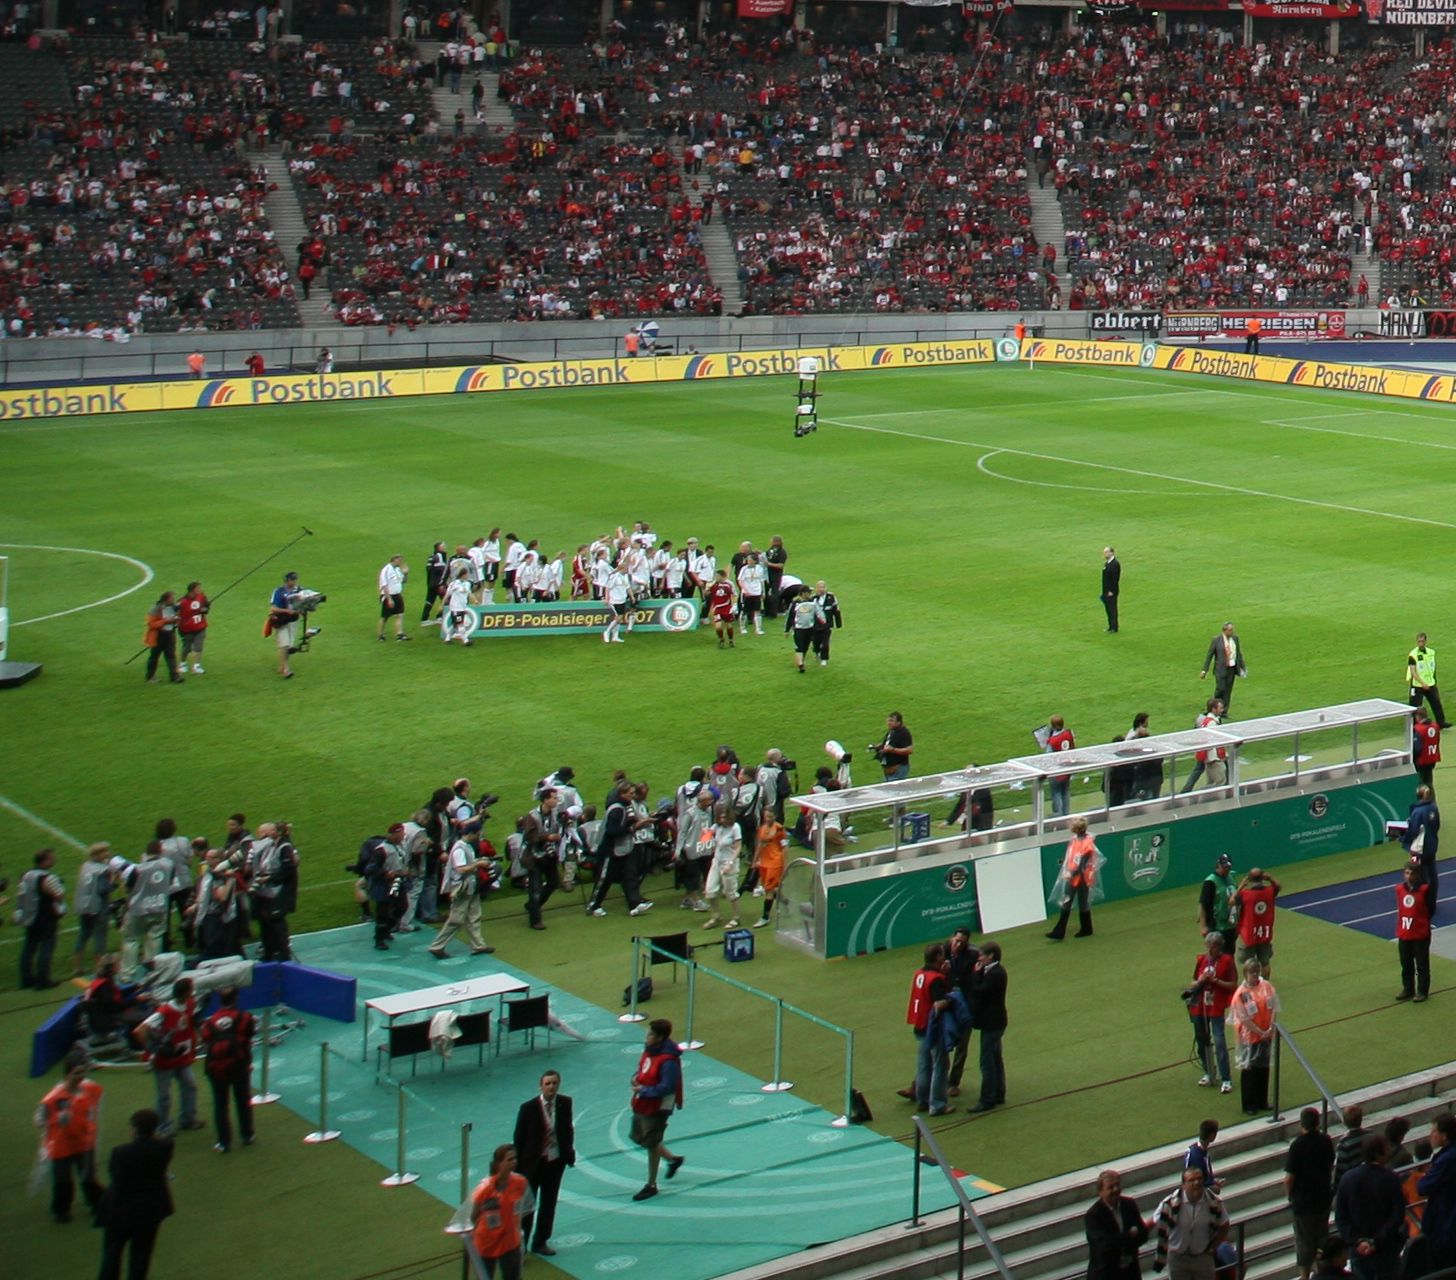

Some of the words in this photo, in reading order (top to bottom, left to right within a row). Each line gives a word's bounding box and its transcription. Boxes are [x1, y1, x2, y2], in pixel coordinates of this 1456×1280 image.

[727, 349, 842, 375] Postbnk
[903, 342, 988, 363] Postbank
[1055, 343, 1134, 363] Postbank
[1190, 351, 1259, 379] Postbank
[252, 371, 394, 403] Postbank
[503, 359, 631, 388] Postbank
[1313, 364, 1389, 394] Postbank
[482, 610, 609, 629] DFB-Pokalsieger
